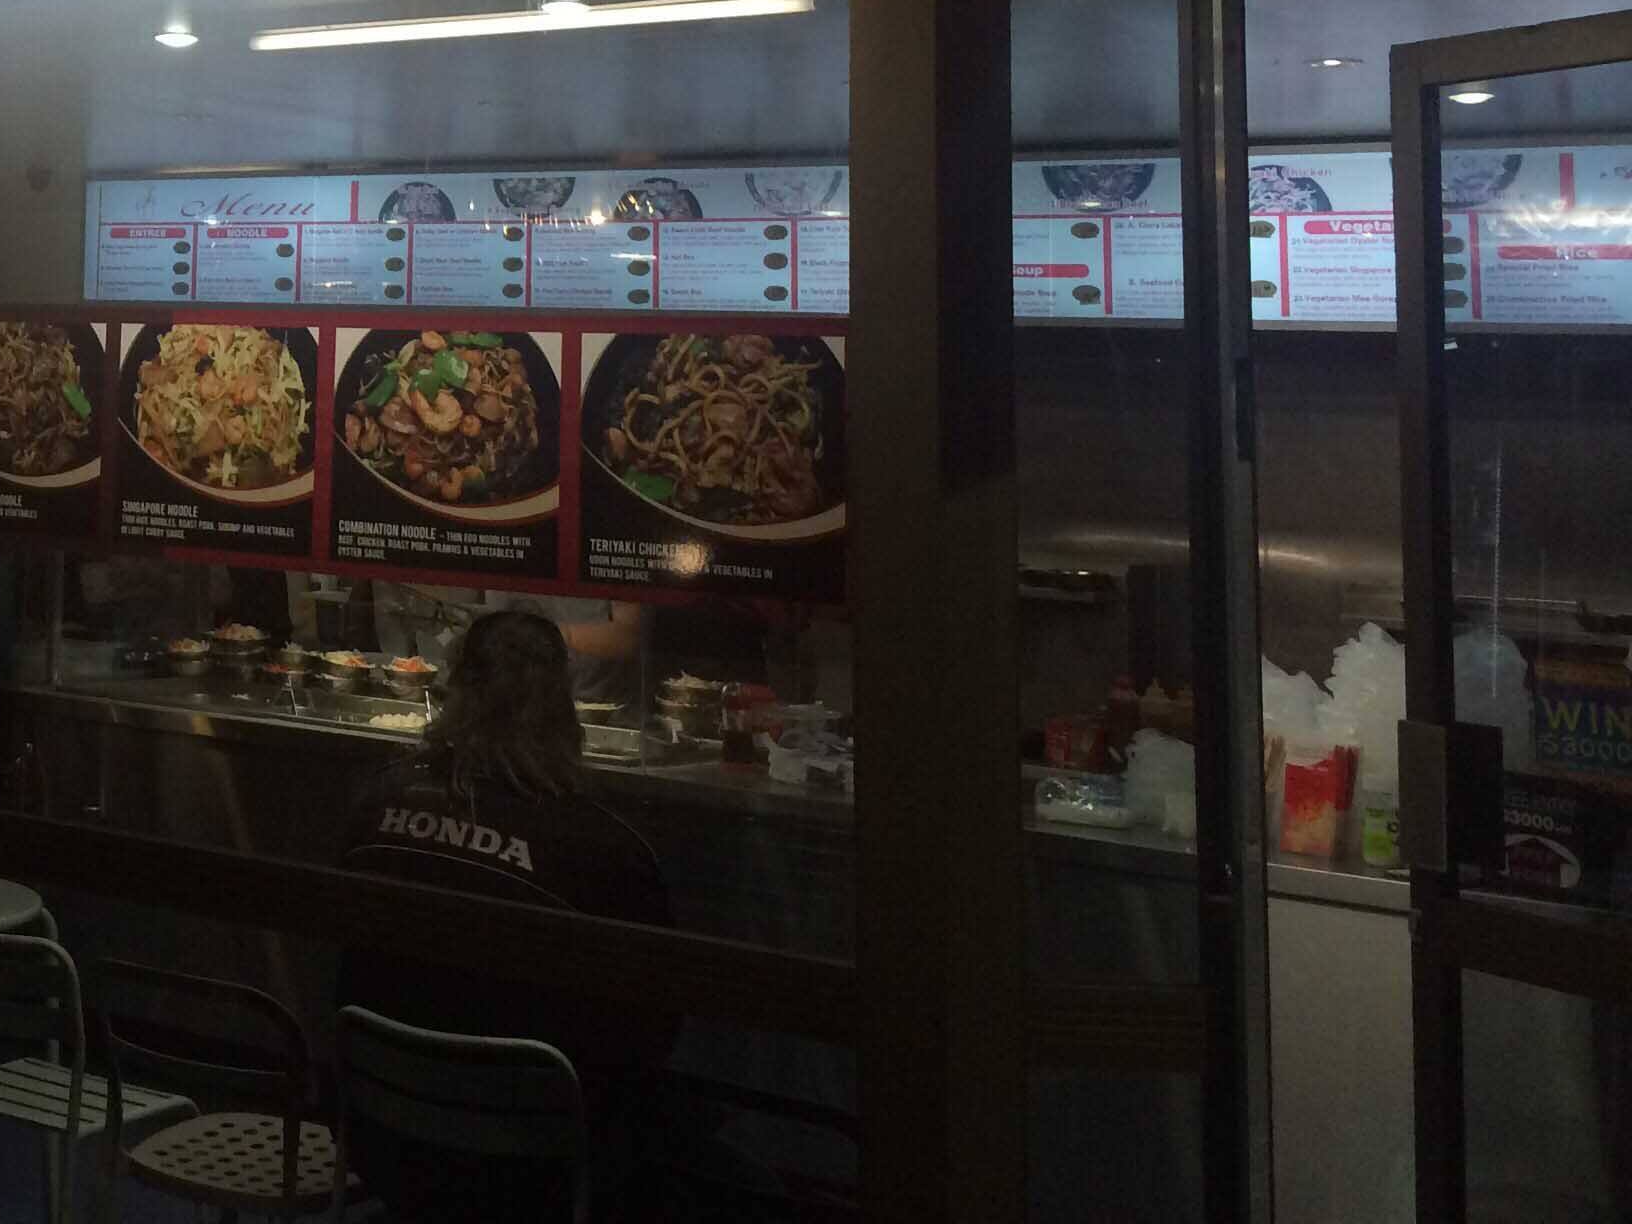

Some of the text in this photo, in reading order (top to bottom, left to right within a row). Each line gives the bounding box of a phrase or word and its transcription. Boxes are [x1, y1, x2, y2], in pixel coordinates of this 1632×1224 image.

[180, 191, 316, 217] Menu
[121, 500, 200, 519] SINGAPORE NOODLE
[338, 519, 400, 537] COMBINATION
[401, 524, 438, 541] NOODLE
[590, 538, 637, 555] TERIYAKI
[590, 567, 623, 579] TERIYAKI
[711, 564, 763, 579] VEGETABLES
[377, 806, 535, 874] HONDA
